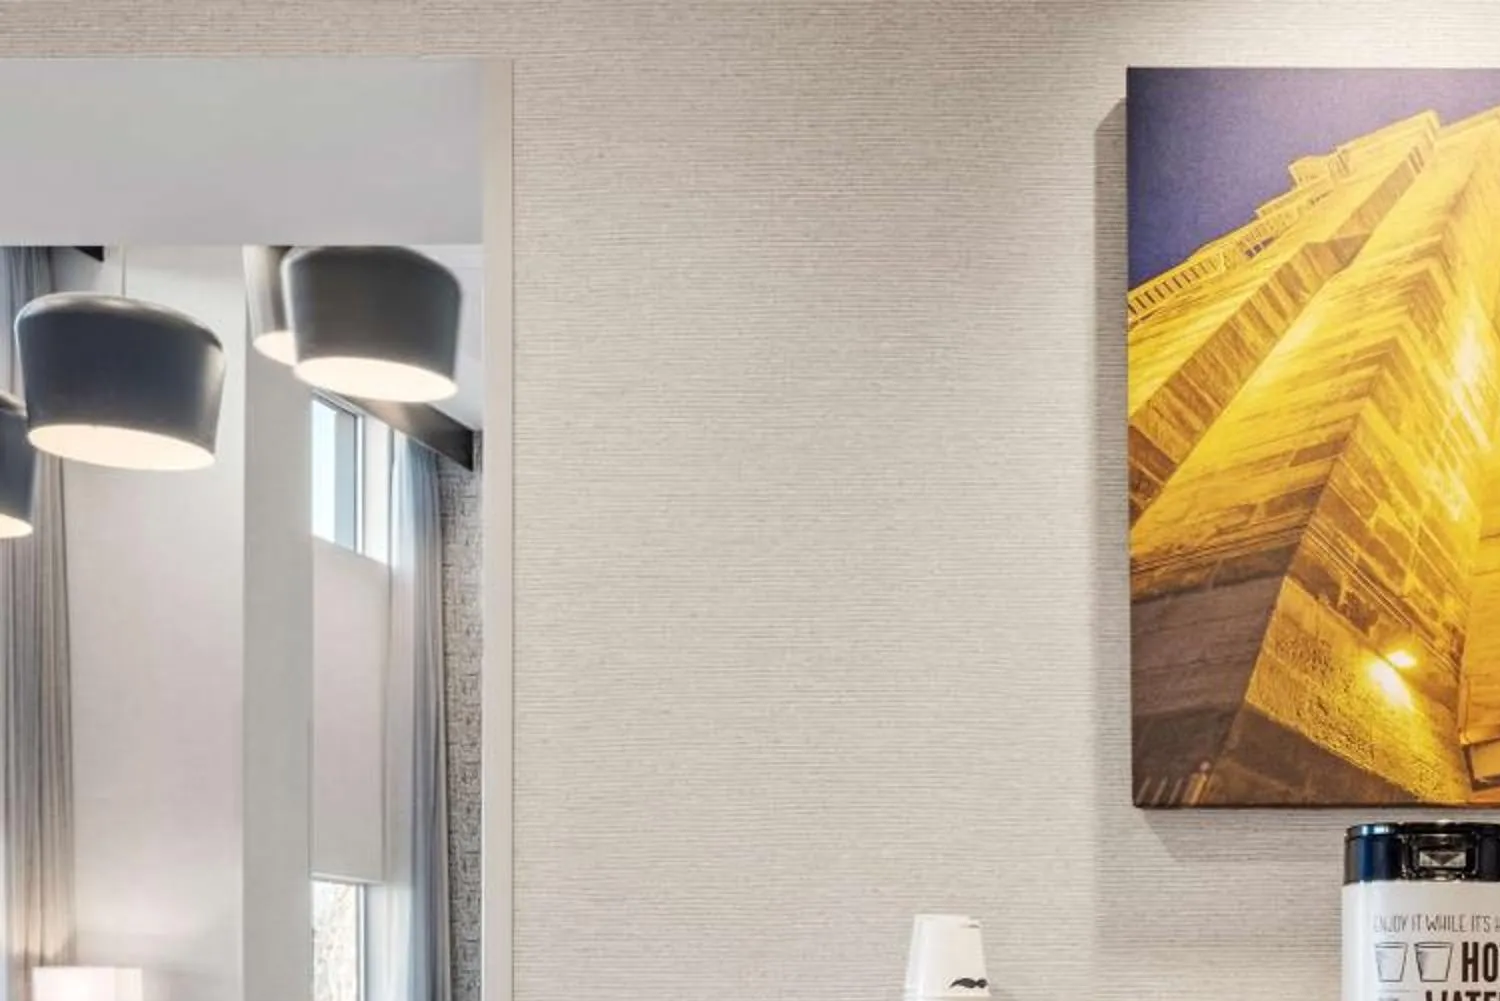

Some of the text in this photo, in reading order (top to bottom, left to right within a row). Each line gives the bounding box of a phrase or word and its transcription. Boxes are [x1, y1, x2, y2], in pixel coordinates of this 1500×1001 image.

[1411, 914, 1422, 932] IT
[1426, 914, 1467, 932] WHILE
[1471, 915, 1491, 933] IT'S
